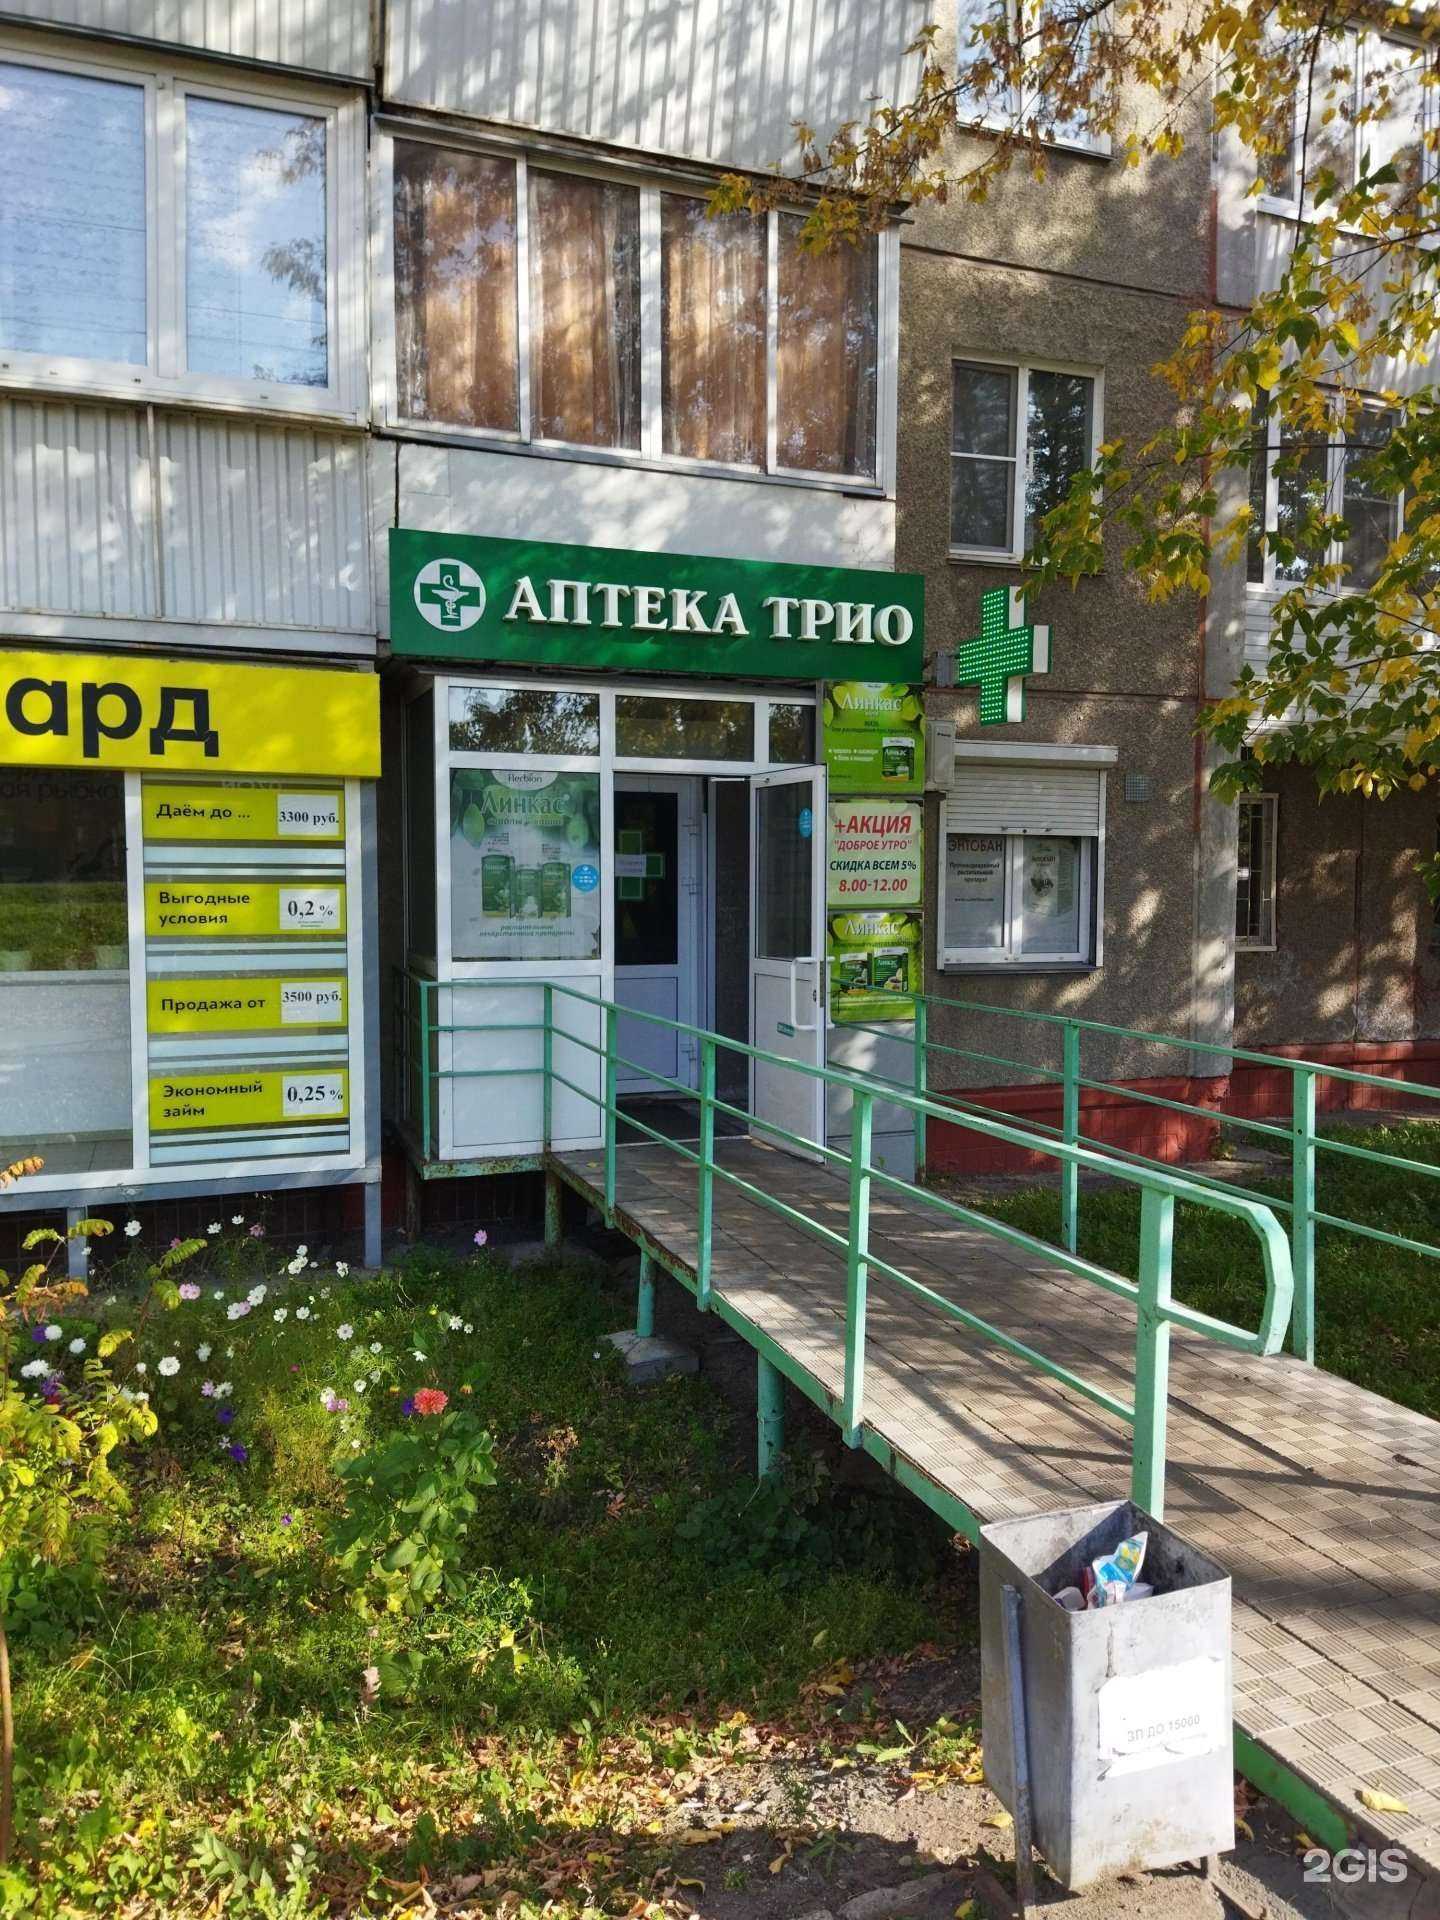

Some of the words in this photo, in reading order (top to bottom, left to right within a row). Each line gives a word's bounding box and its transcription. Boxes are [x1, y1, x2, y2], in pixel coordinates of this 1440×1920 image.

[502, 575, 750, 637] АПТЕКА
[762, 596, 914, 647] ТРИО
[5, 677, 220, 758] ард
[156, 804, 205, 819] Даём
[210, 808, 233, 819] до
[279, 811, 309, 823] 3300
[313, 812, 340, 826] руб.
[835, 840, 880, 852] "ДОБРОЕ
[881, 840, 912, 850] УТРО"
[830, 861, 871, 872] СКИДКА
[872, 861, 899, 870] ВСЕМ
[901, 861, 917, 870] 5%
[838, 879, 908, 892] 8.00-12.00
[159, 892, 250, 905] Выгодные
[288, 900, 314, 918] 0,2
[319, 905, 333, 916] %
[159, 914, 228, 927] условия
[282, 991, 312, 1003] 3500
[316, 990, 342, 1004] руб.
[161, 999, 242, 1014] Продажа
[247, 999, 266, 1008] от
[163, 1081, 263, 1098] Экономный
[287, 1086, 326, 1103] 0,25
[329, 1090, 343, 1100] %
[163, 1104, 205, 1117] займ
[1127, 1729, 1144, 1742] ЗП
[1147, 1723, 1165, 1738] ДО
[1168, 1714, 1200, 1731] 15000
